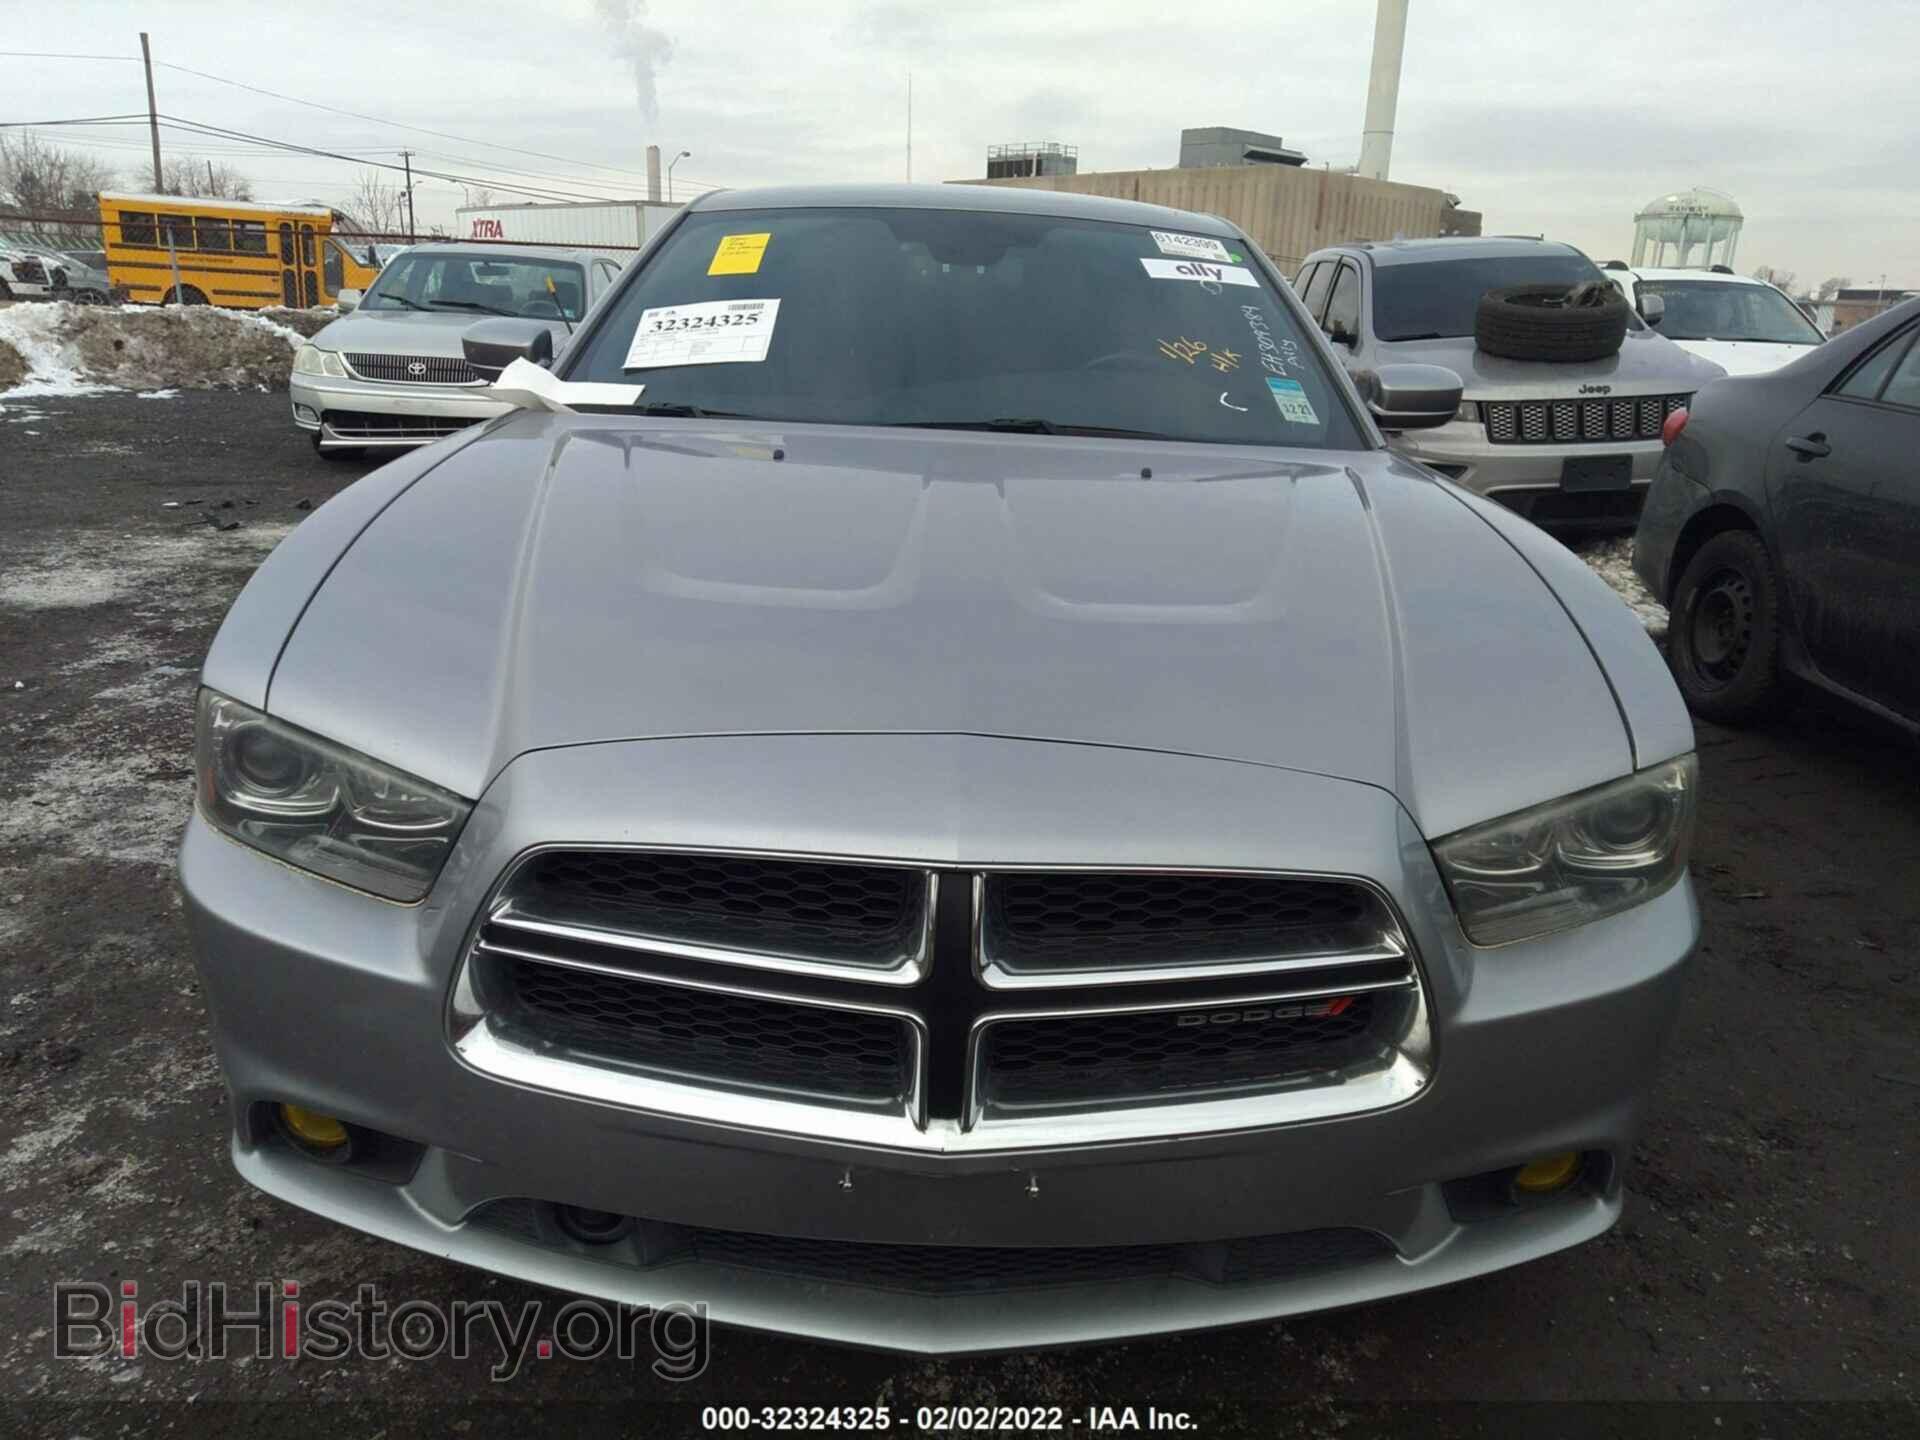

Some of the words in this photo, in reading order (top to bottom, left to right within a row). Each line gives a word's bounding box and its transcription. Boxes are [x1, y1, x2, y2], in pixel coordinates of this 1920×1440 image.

[472, 218, 504, 238] XTRA
[1175, 263, 1222, 281] ally
[649, 312, 762, 333] 32324325
[1578, 384, 1612, 396] Jeep
[1176, 1004, 1333, 1027] DODGE
